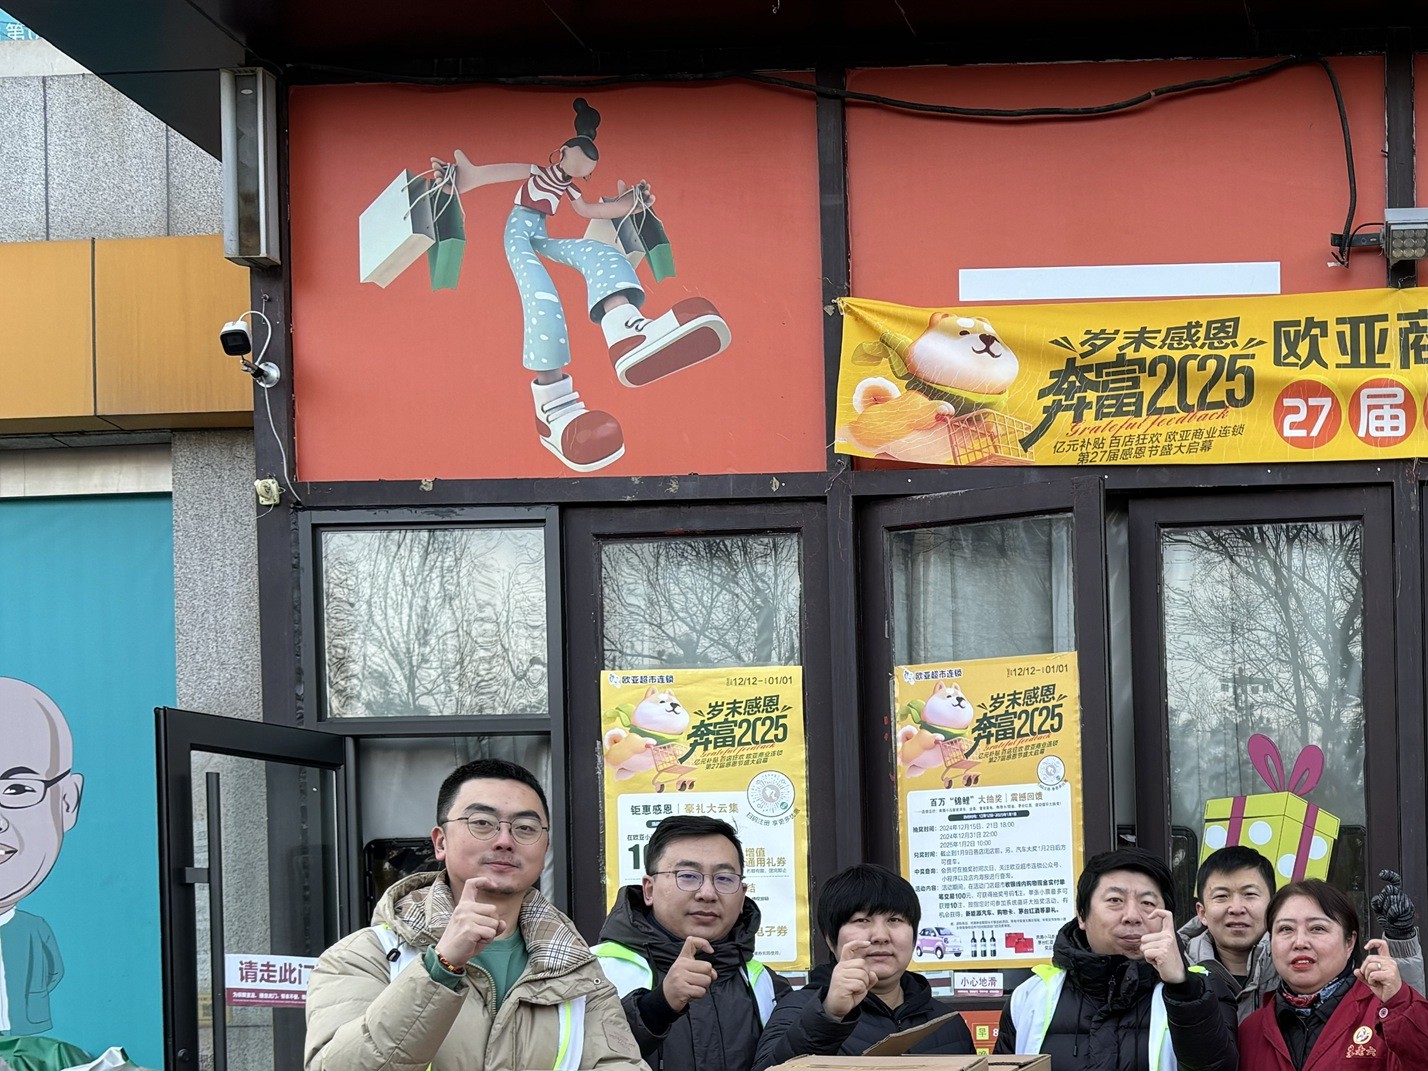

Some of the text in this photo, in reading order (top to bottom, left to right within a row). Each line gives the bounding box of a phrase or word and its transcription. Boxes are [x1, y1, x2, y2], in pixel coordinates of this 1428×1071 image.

[1079, 316, 1241, 359] 岁末感恩
[1019, 353, 1257, 453] 奔富2025
[1068, 406, 1231, 440] Grateful feedback
[1052, 423, 1246, 454] 亿元补贴 百店狂欢 欧亚商业连锁
[1076, 440, 1214, 465] 第27届感恩节盛大启幕
[621, 674, 674, 684] 欧亚超市连锁
[914, 668, 963, 681] 欧亚超市连锁
[706, 694, 780, 721] 岁末感恩
[988, 683, 1057, 713] 岁末感恩
[630, 803, 740, 815] 钜惠感恩 豪礼大云集
[960, 976, 998, 988] 小心地滑
